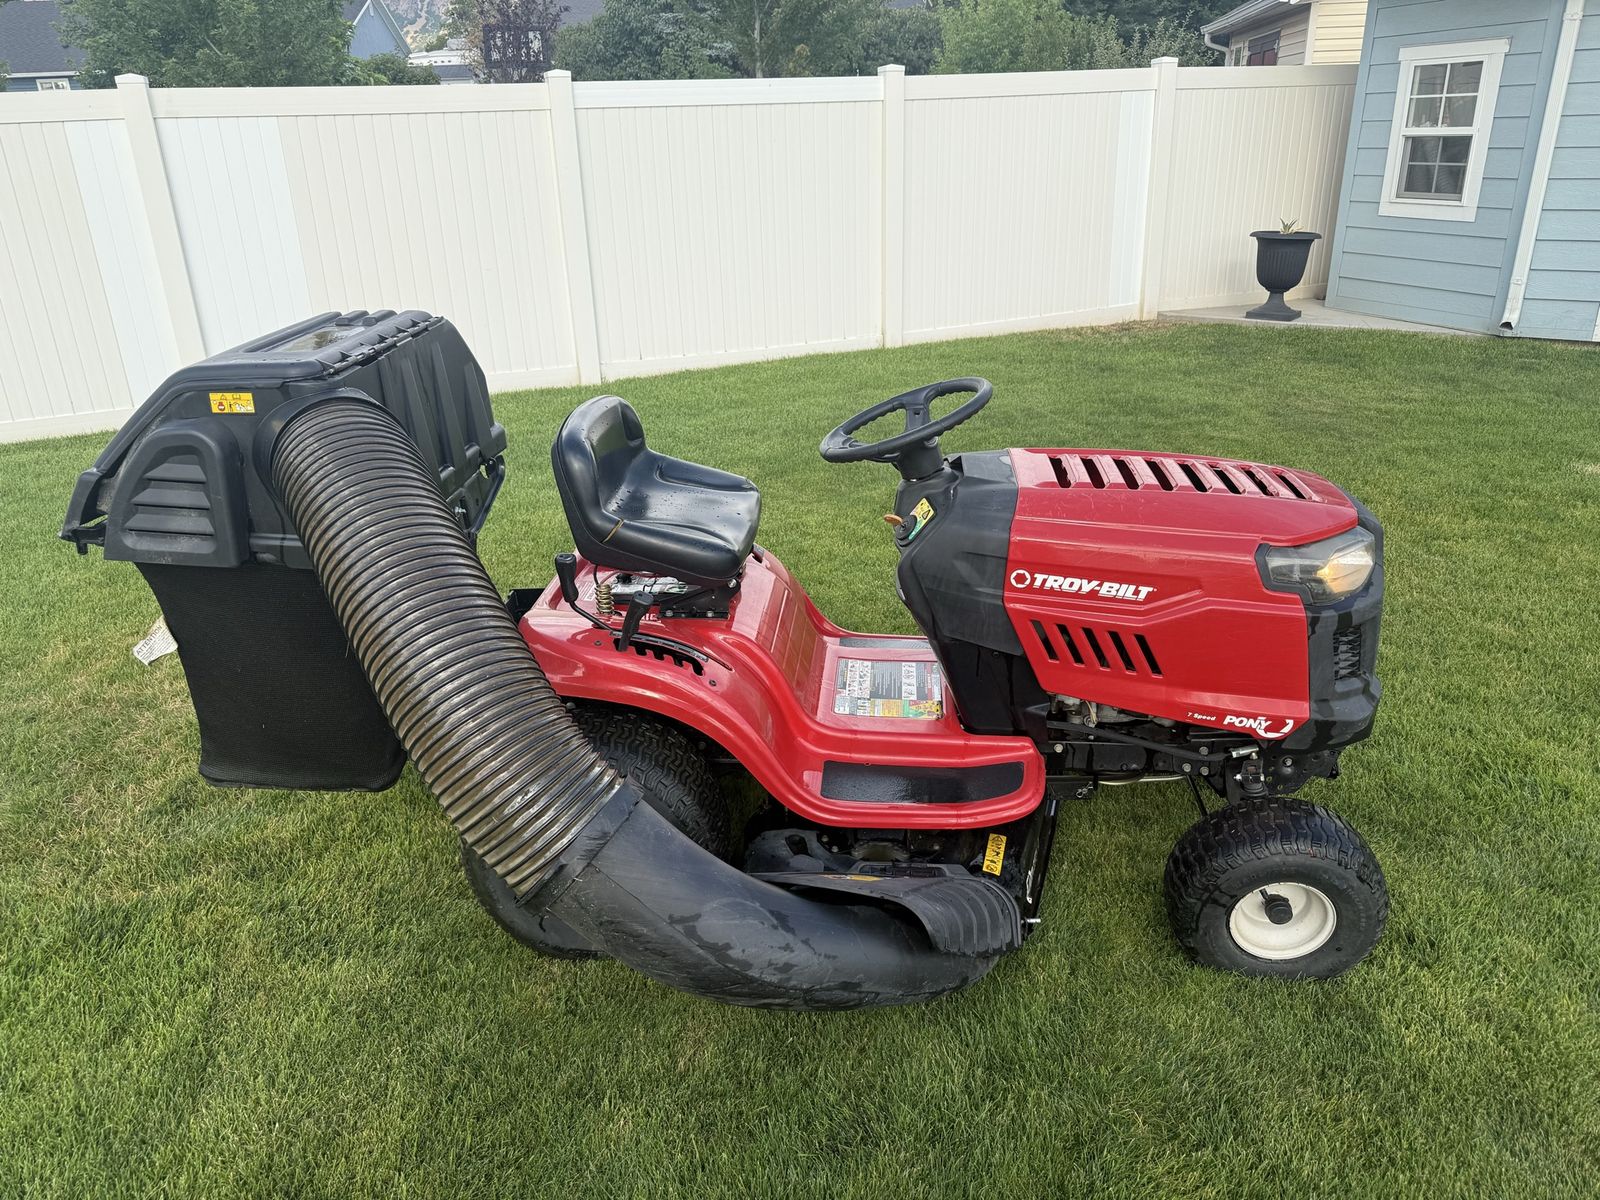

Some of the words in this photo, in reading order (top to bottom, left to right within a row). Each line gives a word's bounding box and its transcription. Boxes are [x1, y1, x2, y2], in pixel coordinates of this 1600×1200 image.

[1032, 573, 1153, 602] TROY-BILT
[136, 625, 162, 654] ATTENTION
[1193, 713, 1216, 721] Speed
[1223, 715, 1272, 729] PONY
